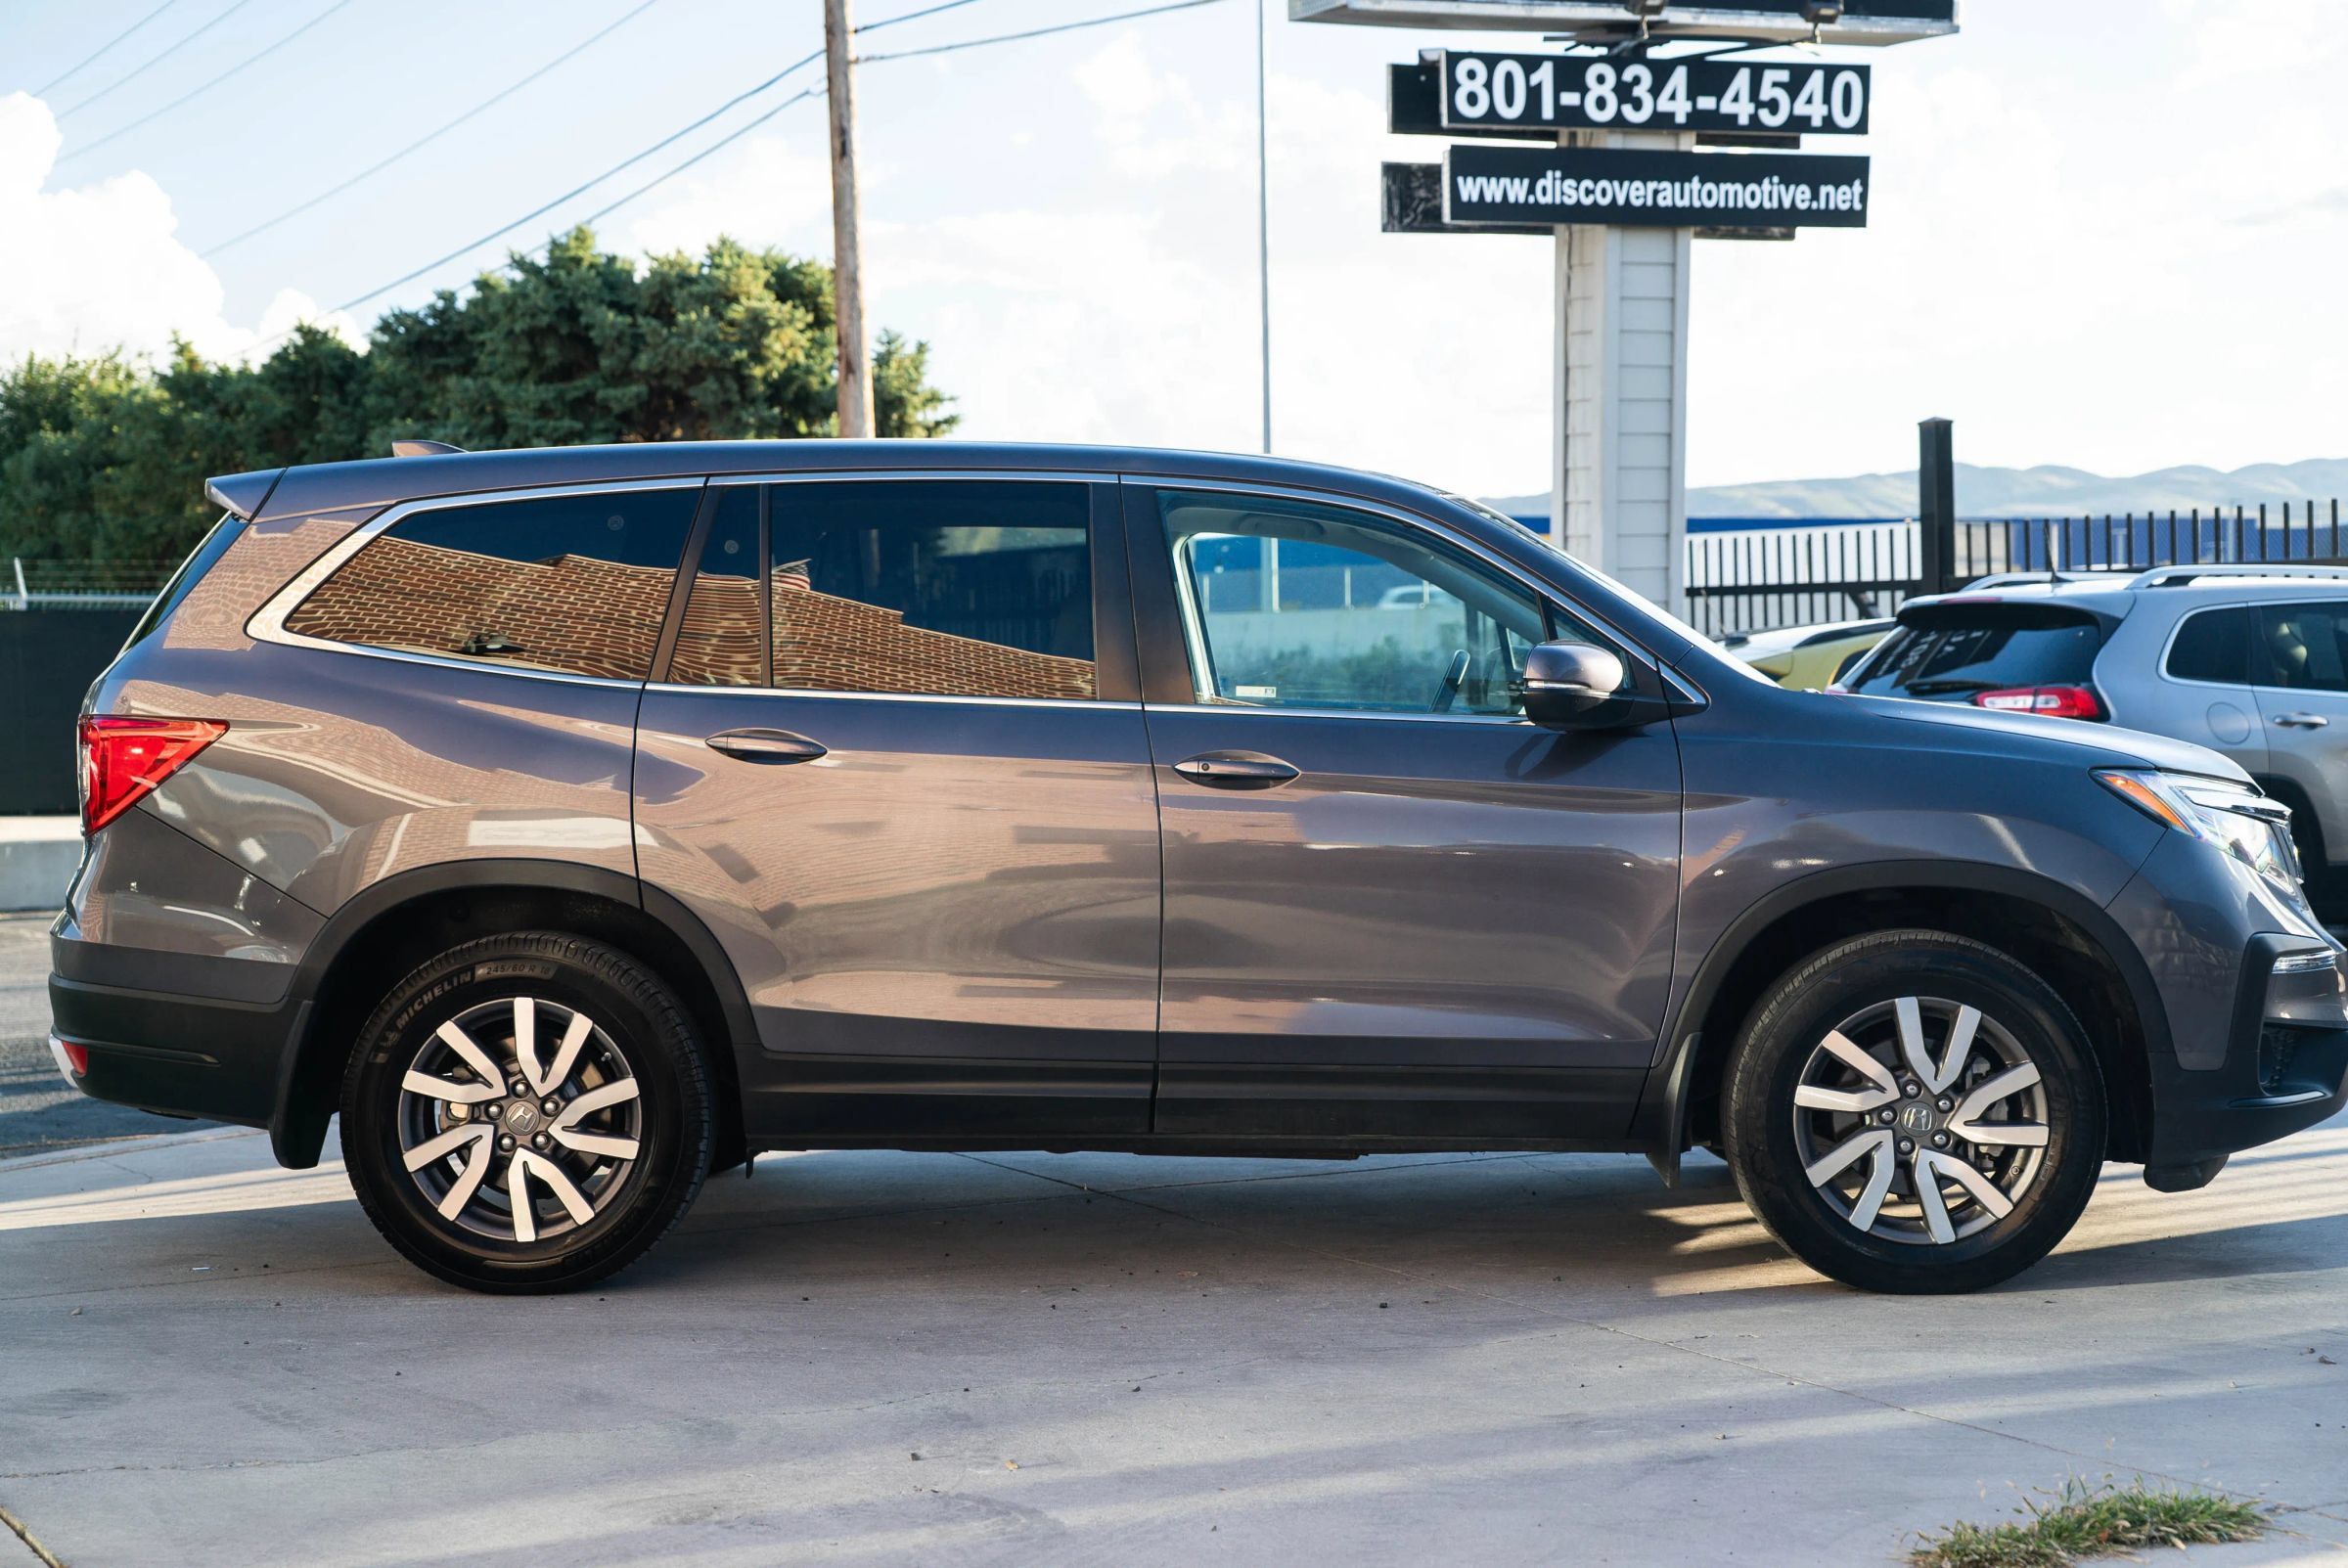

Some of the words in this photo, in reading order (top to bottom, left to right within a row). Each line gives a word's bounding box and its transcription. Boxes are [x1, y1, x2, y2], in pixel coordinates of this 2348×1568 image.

[1455, 58, 1864, 129] 801-834-4540
[1457, 169, 1864, 211] www.discoverautomotive.net
[485, 963, 525, 975] 245/60
[396, 971, 473, 1029] MICHELIN
